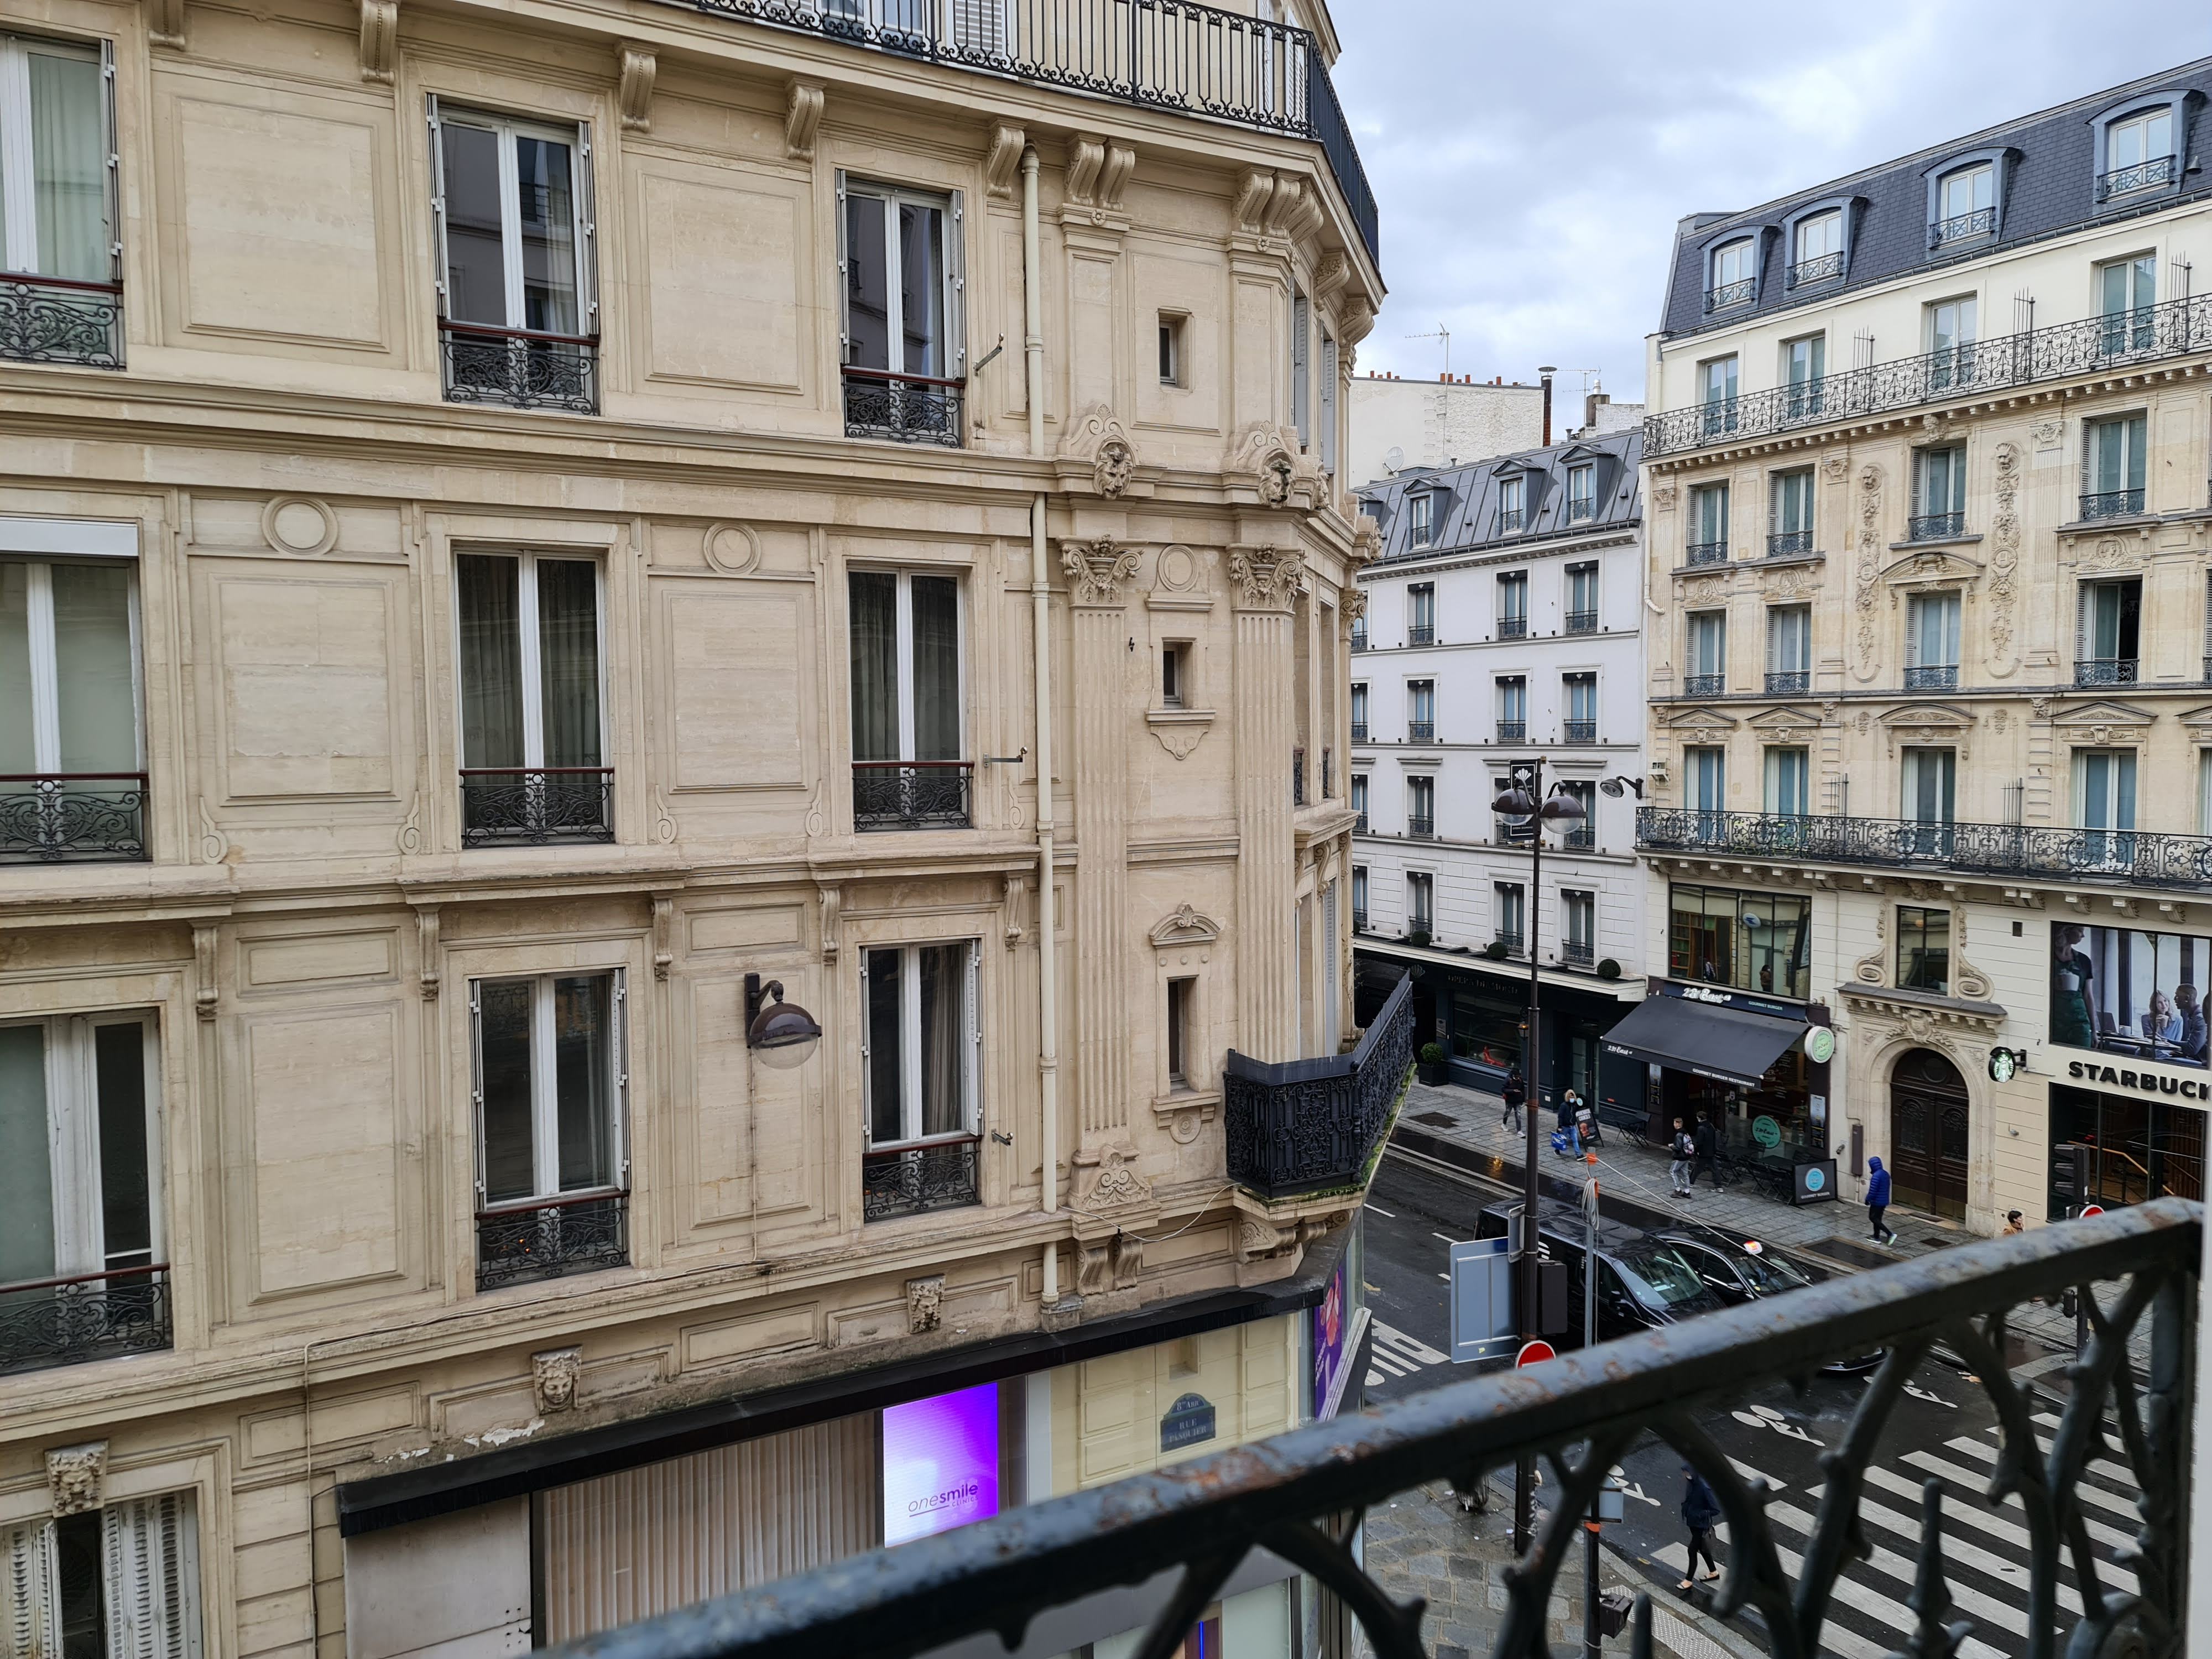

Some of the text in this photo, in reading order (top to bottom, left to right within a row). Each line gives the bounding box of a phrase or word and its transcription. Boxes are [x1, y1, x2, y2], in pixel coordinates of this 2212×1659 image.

[1692, 1068, 1755, 1087] GOURMET BURGER RESTAURANT
[1179, 1417, 1198, 1430] RUE
[1168, 1426, 1207, 1443] PASQUIER
[908, 1483, 978, 1512] onesmile
[952, 1495, 978, 1507] CLINICS
